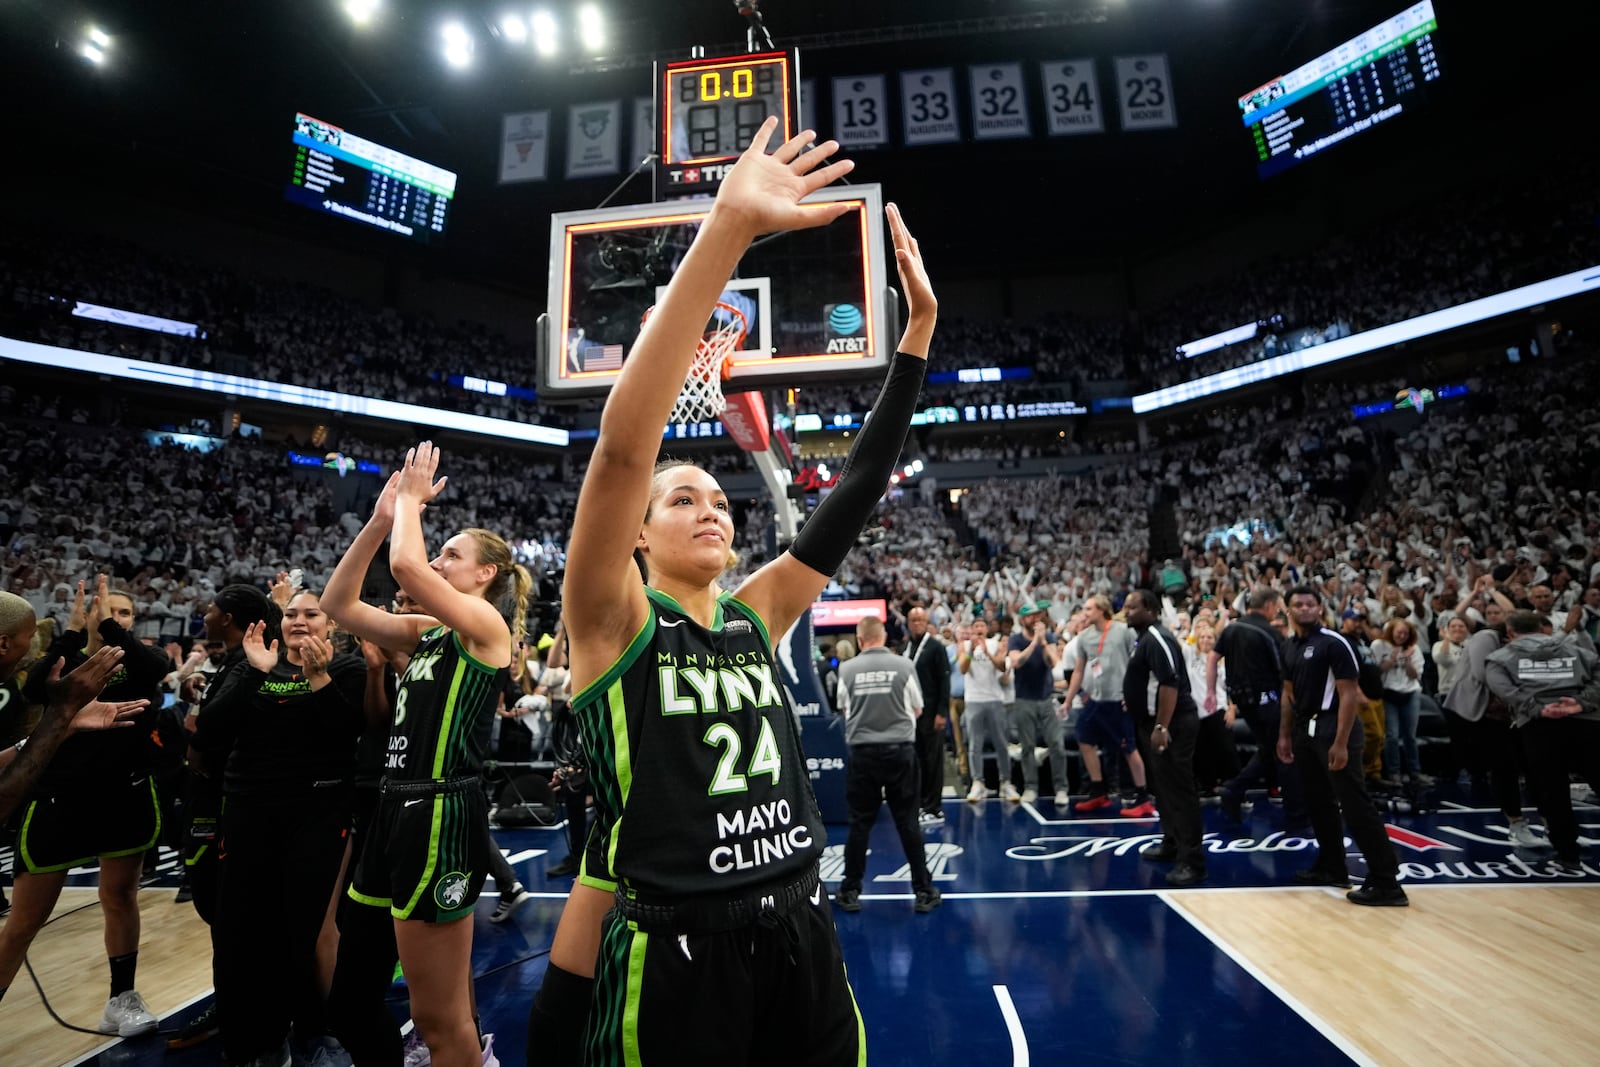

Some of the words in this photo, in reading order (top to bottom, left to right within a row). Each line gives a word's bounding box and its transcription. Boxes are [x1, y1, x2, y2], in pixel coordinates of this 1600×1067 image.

[701, 69, 753, 101] 0.0
[1051, 81, 1094, 113] 34
[1125, 77, 1166, 108] 23
[842, 98, 877, 128] 13
[911, 91, 950, 122] 33
[979, 86, 1020, 117] 32
[1130, 109, 1165, 121] MOORE
[1056, 114, 1094, 126] FOWLES
[701, 164, 736, 182] TIS
[826, 337, 867, 354] AT&T
[855, 671, 898, 684] BEST
[1518, 656, 1577, 669] BEST
[658, 664, 783, 716] LYNX
[703, 716, 781, 796] 24
[716, 799, 791, 840] MAYO
[709, 825, 812, 873] CLINIC
